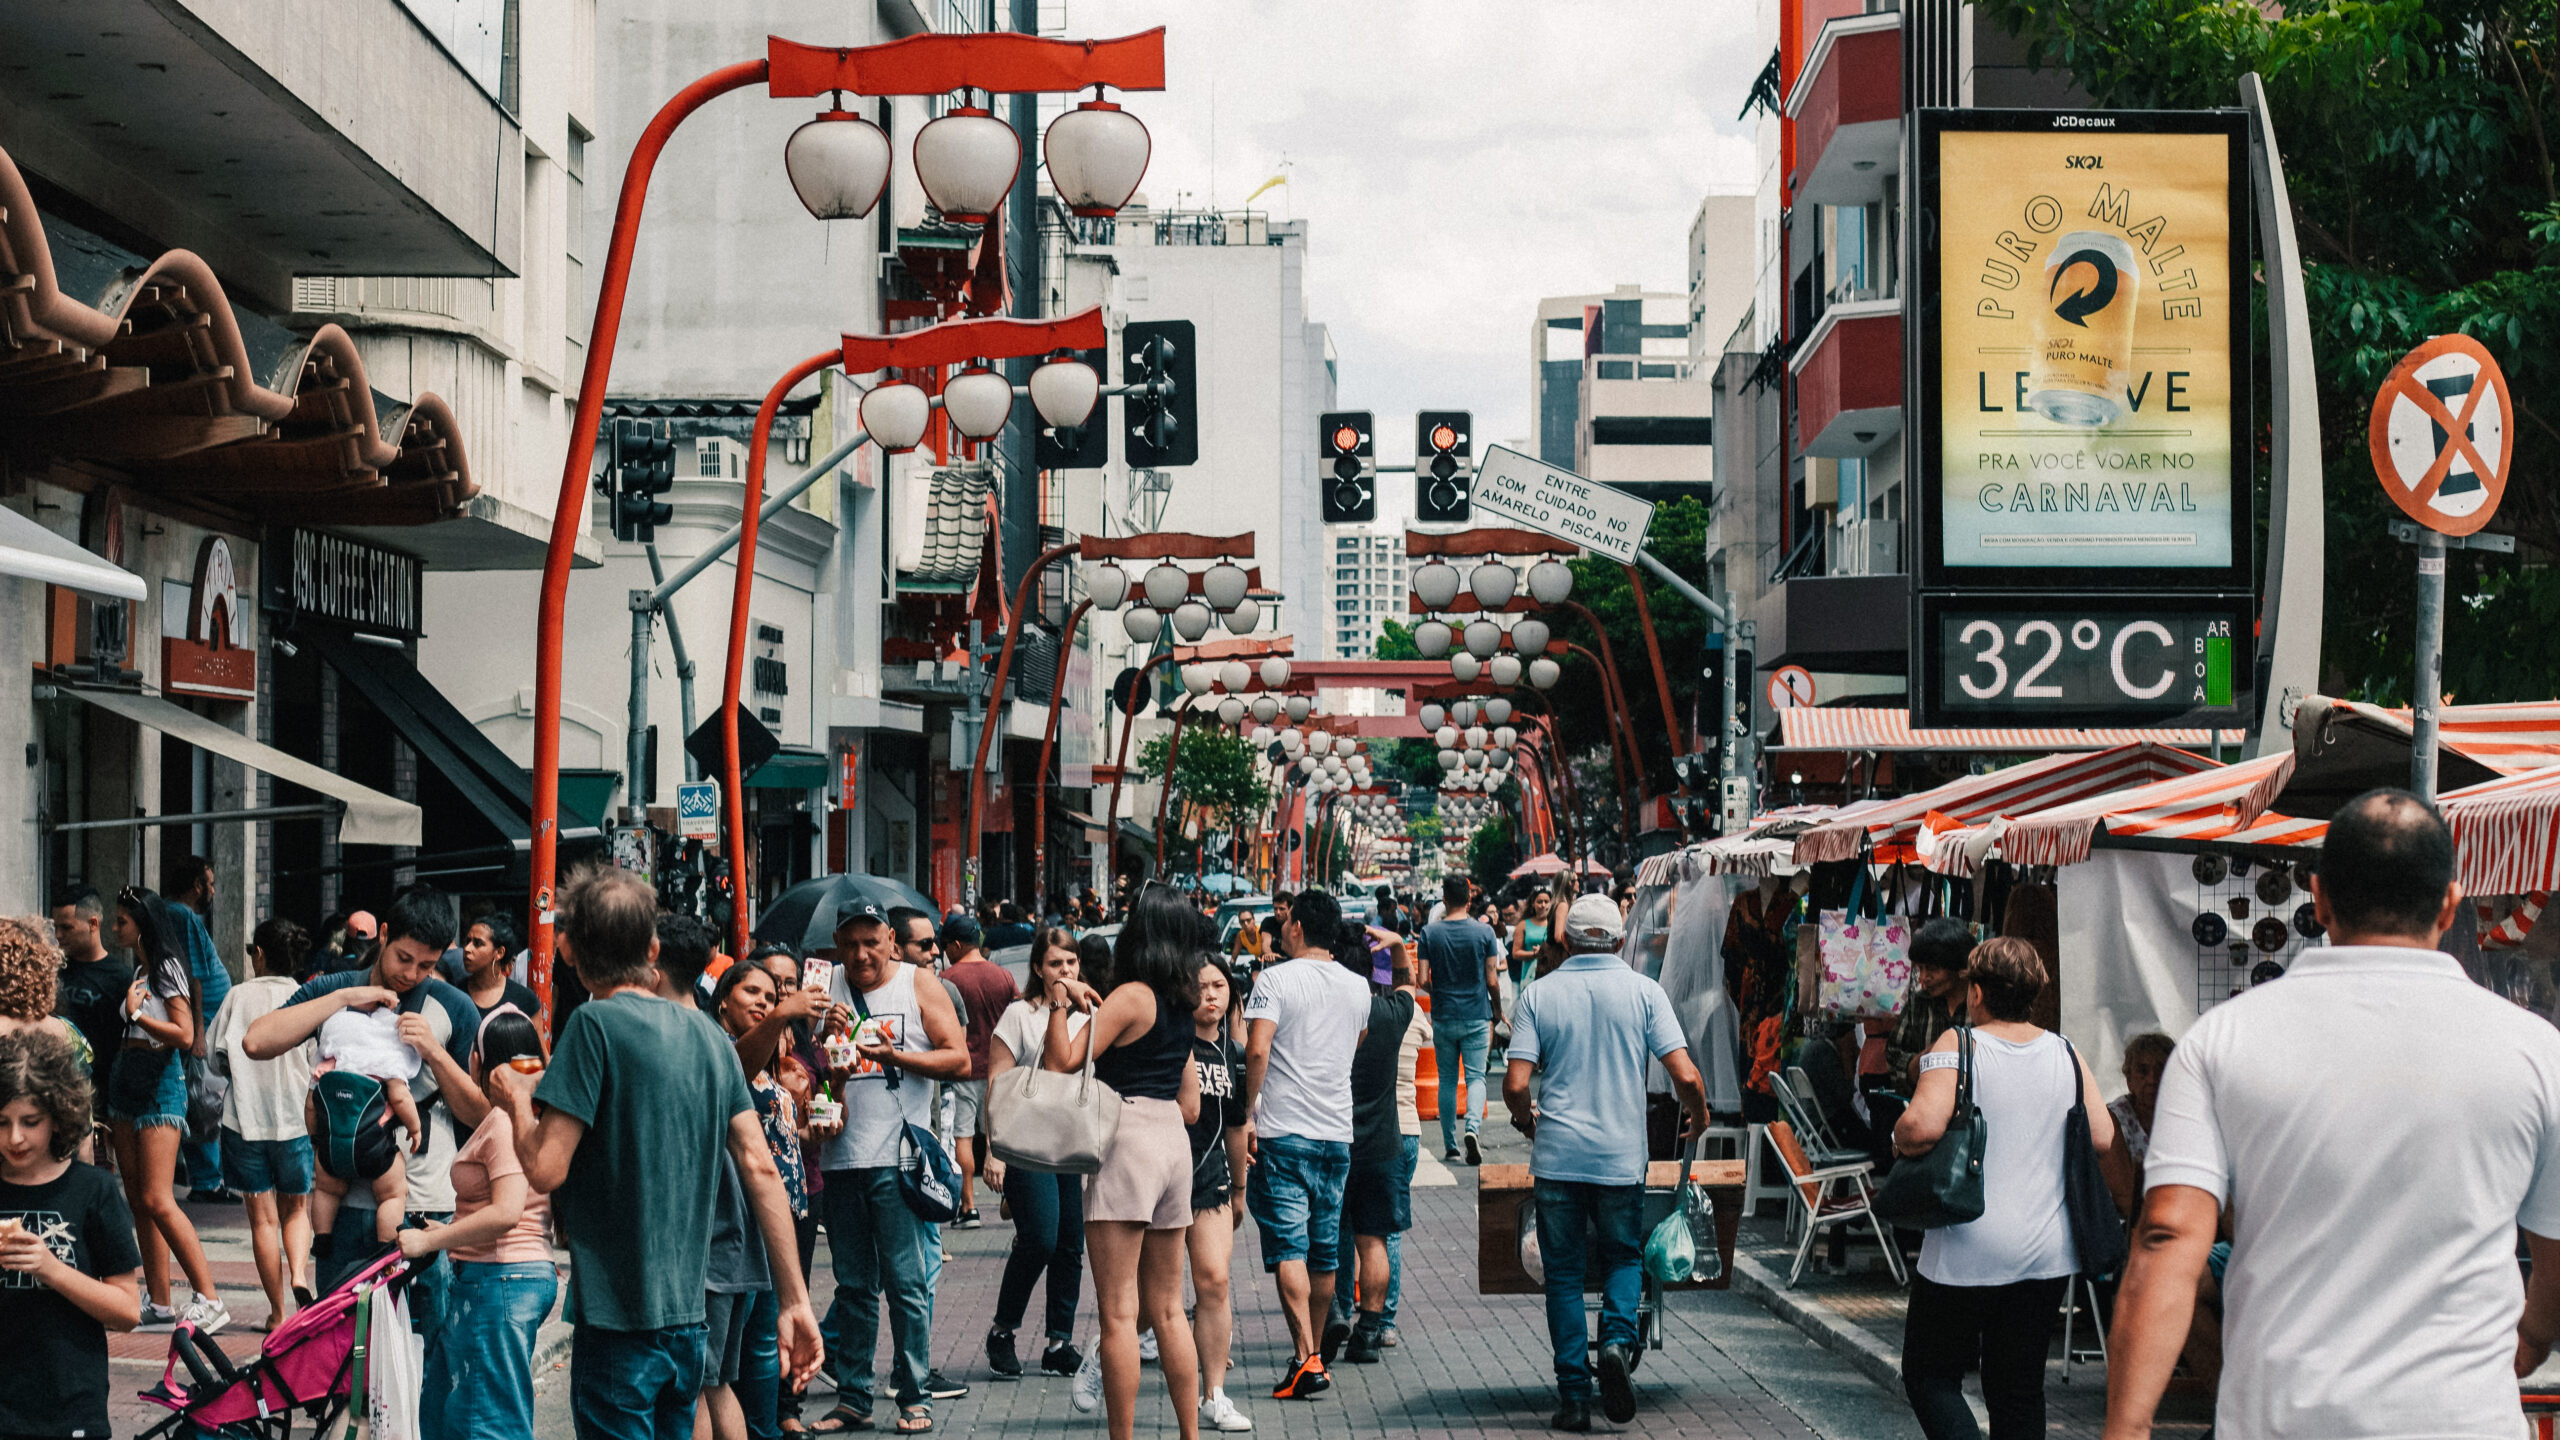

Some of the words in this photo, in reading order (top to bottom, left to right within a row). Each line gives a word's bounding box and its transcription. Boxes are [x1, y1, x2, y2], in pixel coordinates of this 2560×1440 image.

[2052, 115, 2116, 127] JCDecaux
[2065, 154, 2104, 171] SKOL
[1977, 195, 2063, 319] PURO
[2088, 182, 2201, 321] MALTE
[2046, 350, 2076, 361] PURO
[2079, 352, 2113, 370] MALTE
[1979, 453, 2019, 470] PRA
[2029, 449, 2085, 470] VOCÊ
[2095, 452, 2152, 470] VOAR
[2162, 453, 2194, 470] NO
[1545, 474, 1591, 501] ENTRE
[1978, 482, 2197, 513] CARNAVAL
[1496, 475, 1526, 495] COM
[1535, 489, 1597, 521] CUIDADO
[1607, 517, 1628, 533] NO
[1480, 489, 1550, 522] AMARELO
[1561, 518, 1631, 554] PISCANTE
[293, 528, 316, 612] 89C
[321, 534, 365, 621] COFFEE
[369, 548, 414, 631] STATION
[2206, 620, 2231, 637] AR
[1959, 618, 2176, 700] 32°C
[2193, 637, 2206, 701] BOA
